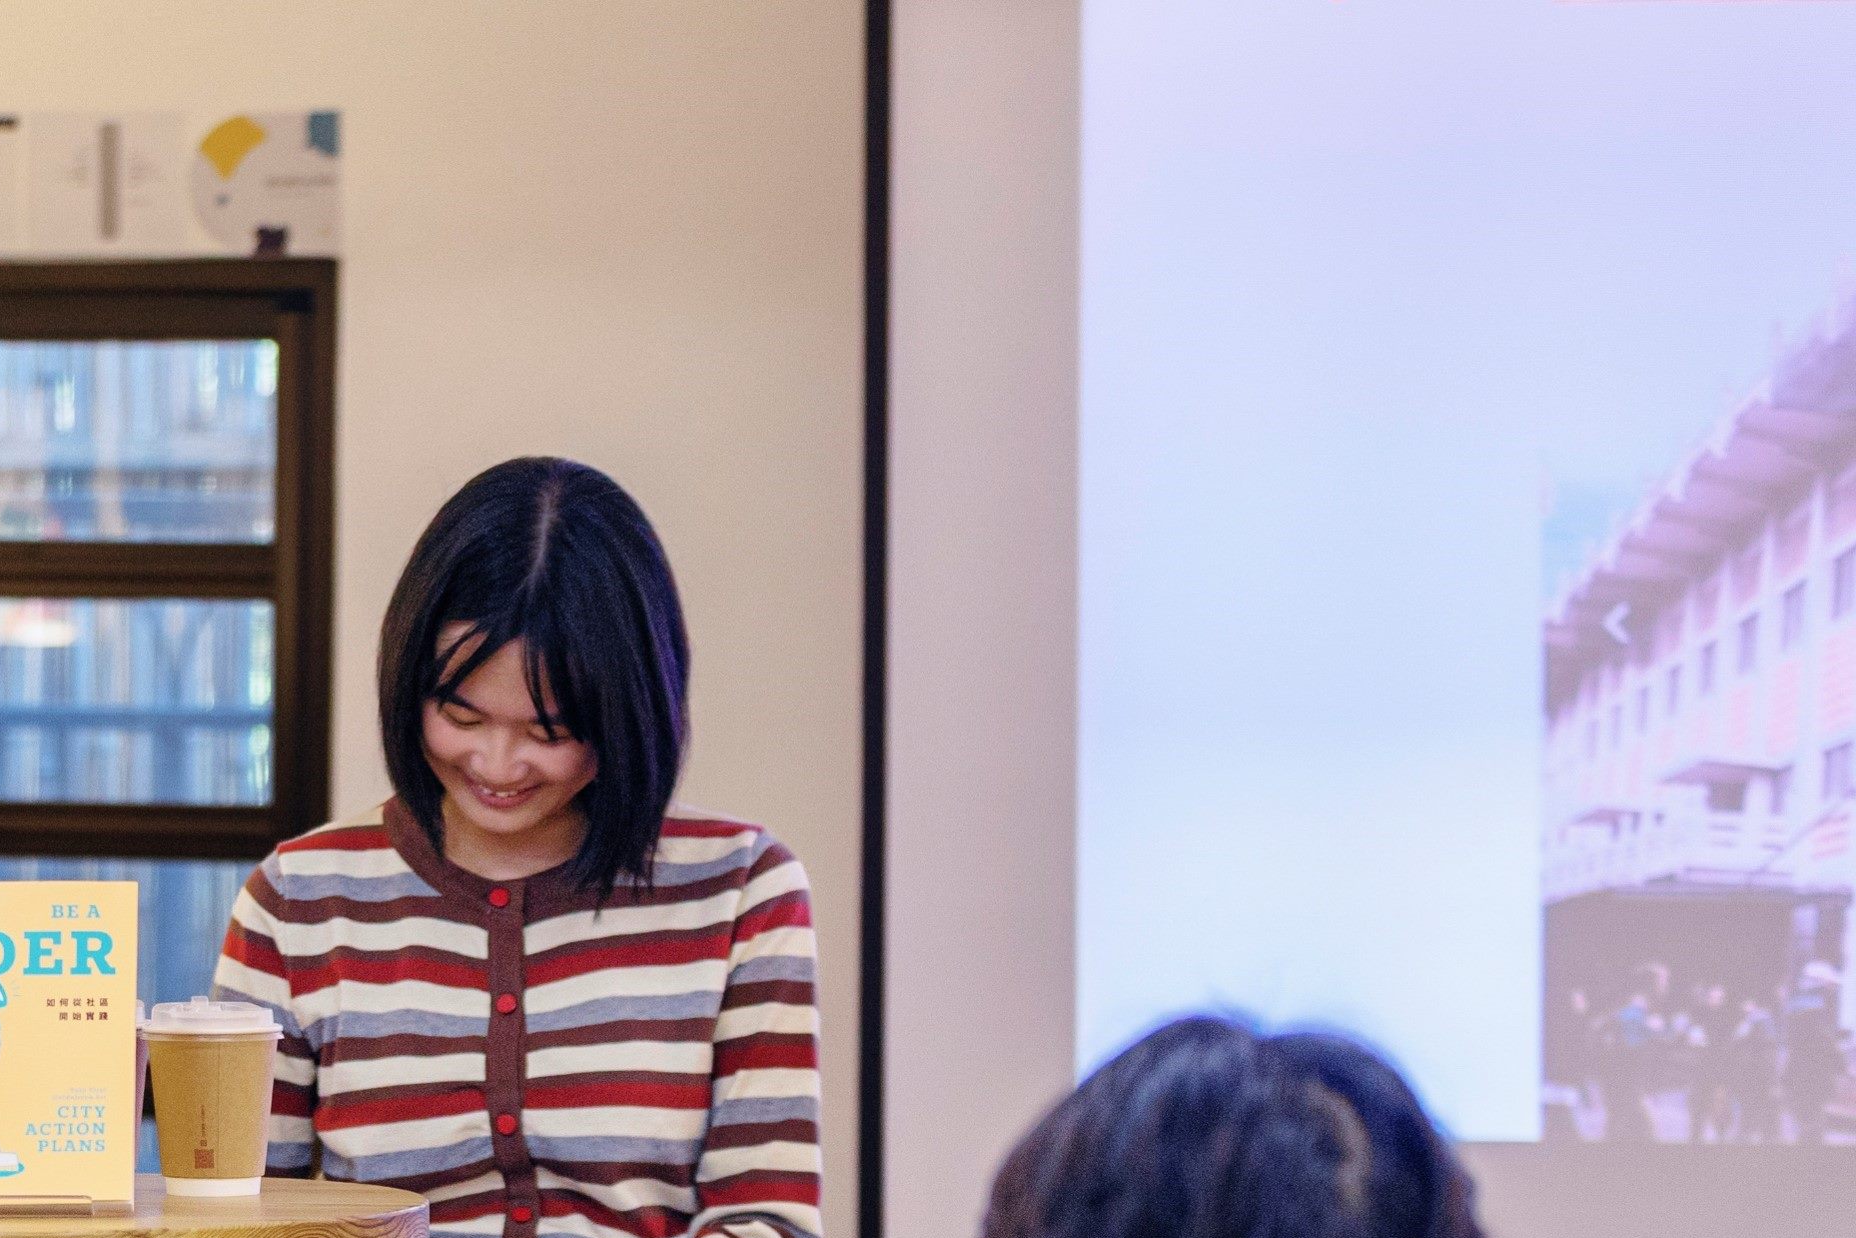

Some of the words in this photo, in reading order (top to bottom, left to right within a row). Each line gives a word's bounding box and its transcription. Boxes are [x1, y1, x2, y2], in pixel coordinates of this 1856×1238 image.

[51, 905, 79, 918] BE
[87, 905, 101, 918] A
[57, 1105, 105, 1118] CITY
[25, 1122, 105, 1136] ACTION
[37, 1140, 105, 1152] PLANS
